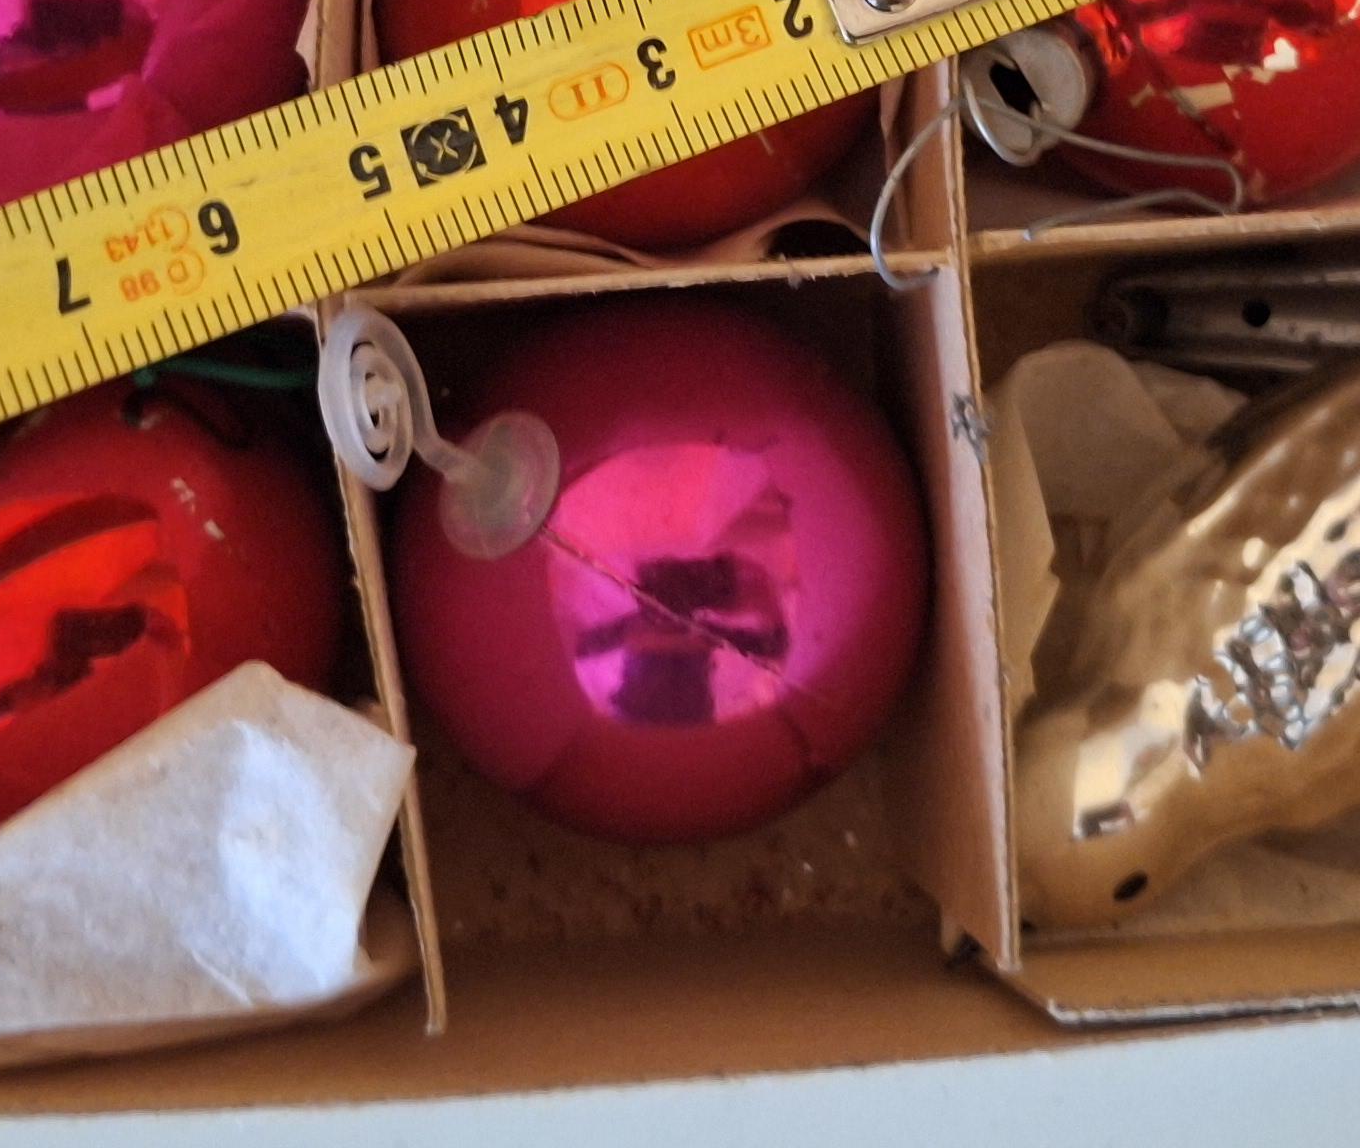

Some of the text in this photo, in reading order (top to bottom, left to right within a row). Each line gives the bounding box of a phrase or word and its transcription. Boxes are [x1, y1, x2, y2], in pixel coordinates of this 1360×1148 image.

[698, 14, 762, 53] 3m
[635, 37, 677, 91] 3
[493, 93, 529, 146] 4
[348, 144, 392, 201] 5
[197, 200, 240, 256] 6
[55, 257, 92, 316] 7
